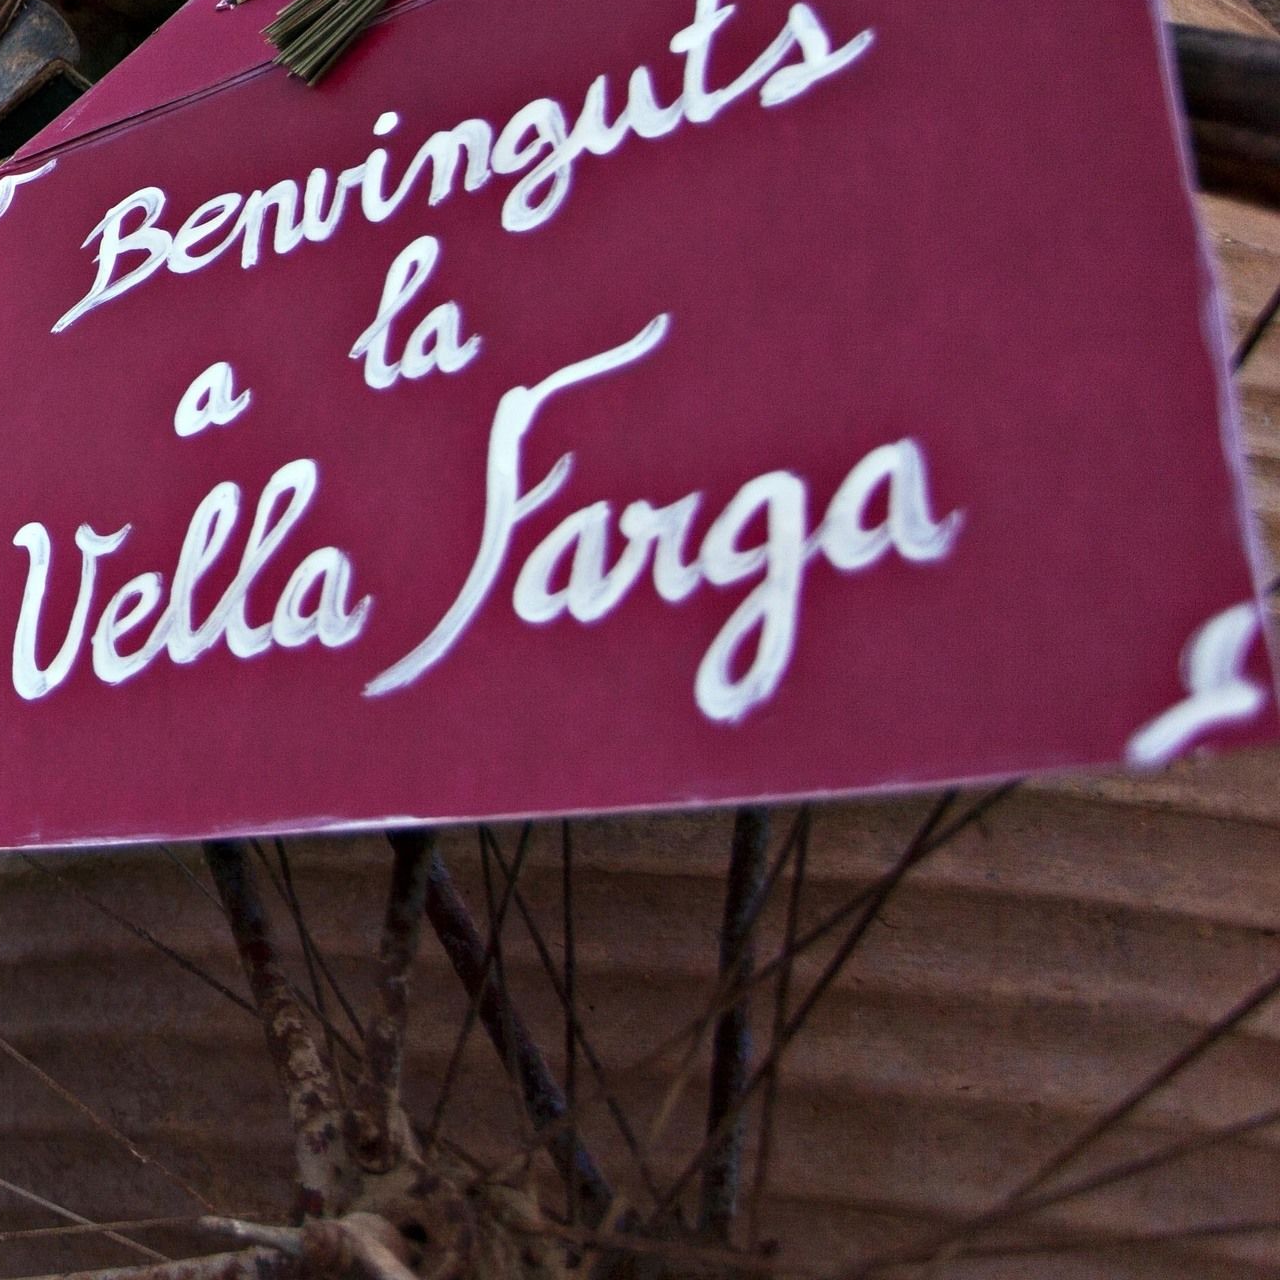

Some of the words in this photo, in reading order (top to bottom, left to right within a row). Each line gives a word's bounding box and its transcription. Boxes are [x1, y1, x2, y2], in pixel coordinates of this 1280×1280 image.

[172, 360, 252, 439] a
[347, 234, 482, 391] la
[11, 457, 373, 702] Vella
[362, 312, 965, 723] Farga
